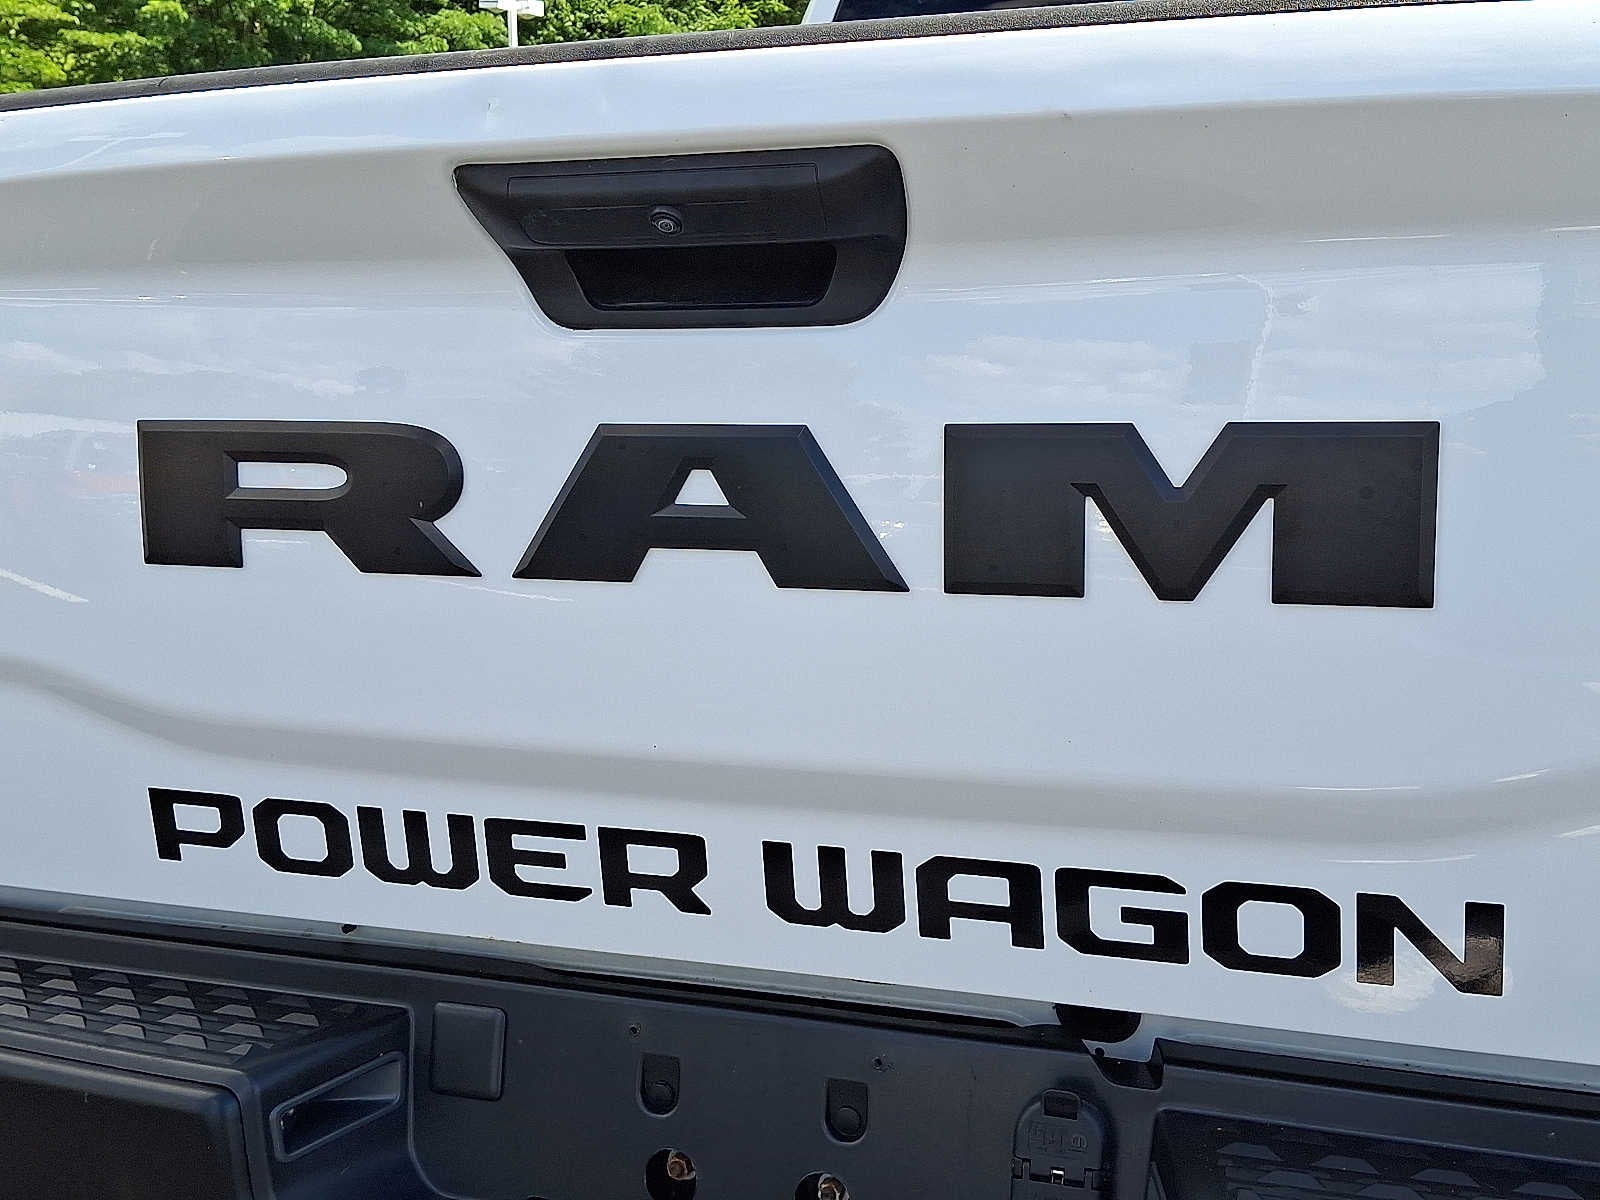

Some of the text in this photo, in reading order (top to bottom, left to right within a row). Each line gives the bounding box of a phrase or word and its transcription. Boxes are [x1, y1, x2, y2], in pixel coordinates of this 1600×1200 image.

[137, 419, 1440, 609] RAM
[148, 787, 1505, 997] POWER WAGON
